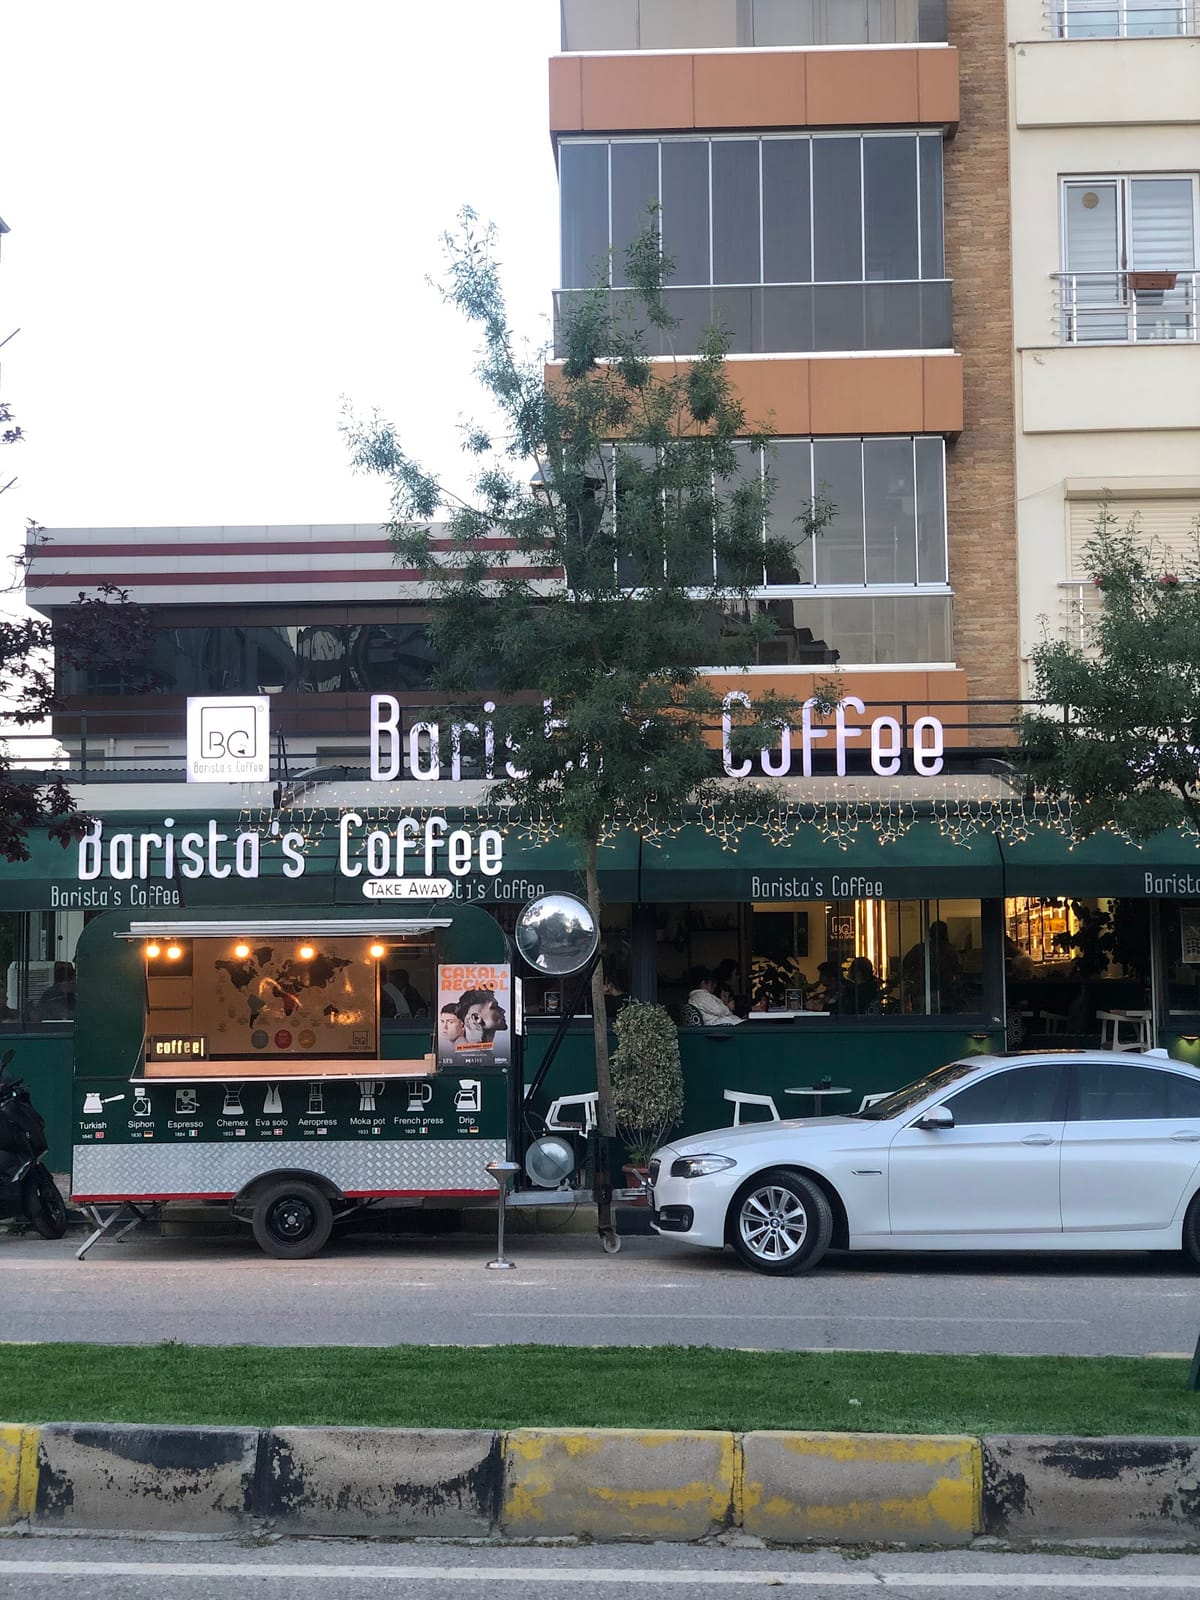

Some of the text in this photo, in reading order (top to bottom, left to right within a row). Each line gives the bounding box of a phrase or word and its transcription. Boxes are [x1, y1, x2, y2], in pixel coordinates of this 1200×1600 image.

[722, 690, 943, 778] Coffee
[193, 760, 264, 774] Barista's Coffee
[78, 813, 503, 880] Barista's Coffee
[368, 882, 402, 896] TAKE
[409, 882, 448, 896] AWAY
[494, 878, 545, 899] Coffee
[752, 875, 883, 898] Barista's Coffee
[51, 884, 180, 907] Barista's Coffee
[441, 980, 508, 991] RECKOL
[156, 1040, 200, 1054] coffee
[79, 1121, 107, 1129] Turkish
[127, 1120, 155, 1129] Siphon
[167, 1120, 204, 1129] Espresso
[216, 1118, 249, 1127] Chemex
[255, 1118, 288, 1126] Eva solo
[298, 1118, 338, 1127] Aeropress
[350, 1117, 386, 1126] Moka pot
[394, 1116, 444, 1126] French press
[459, 1116, 475, 1125] Drip
